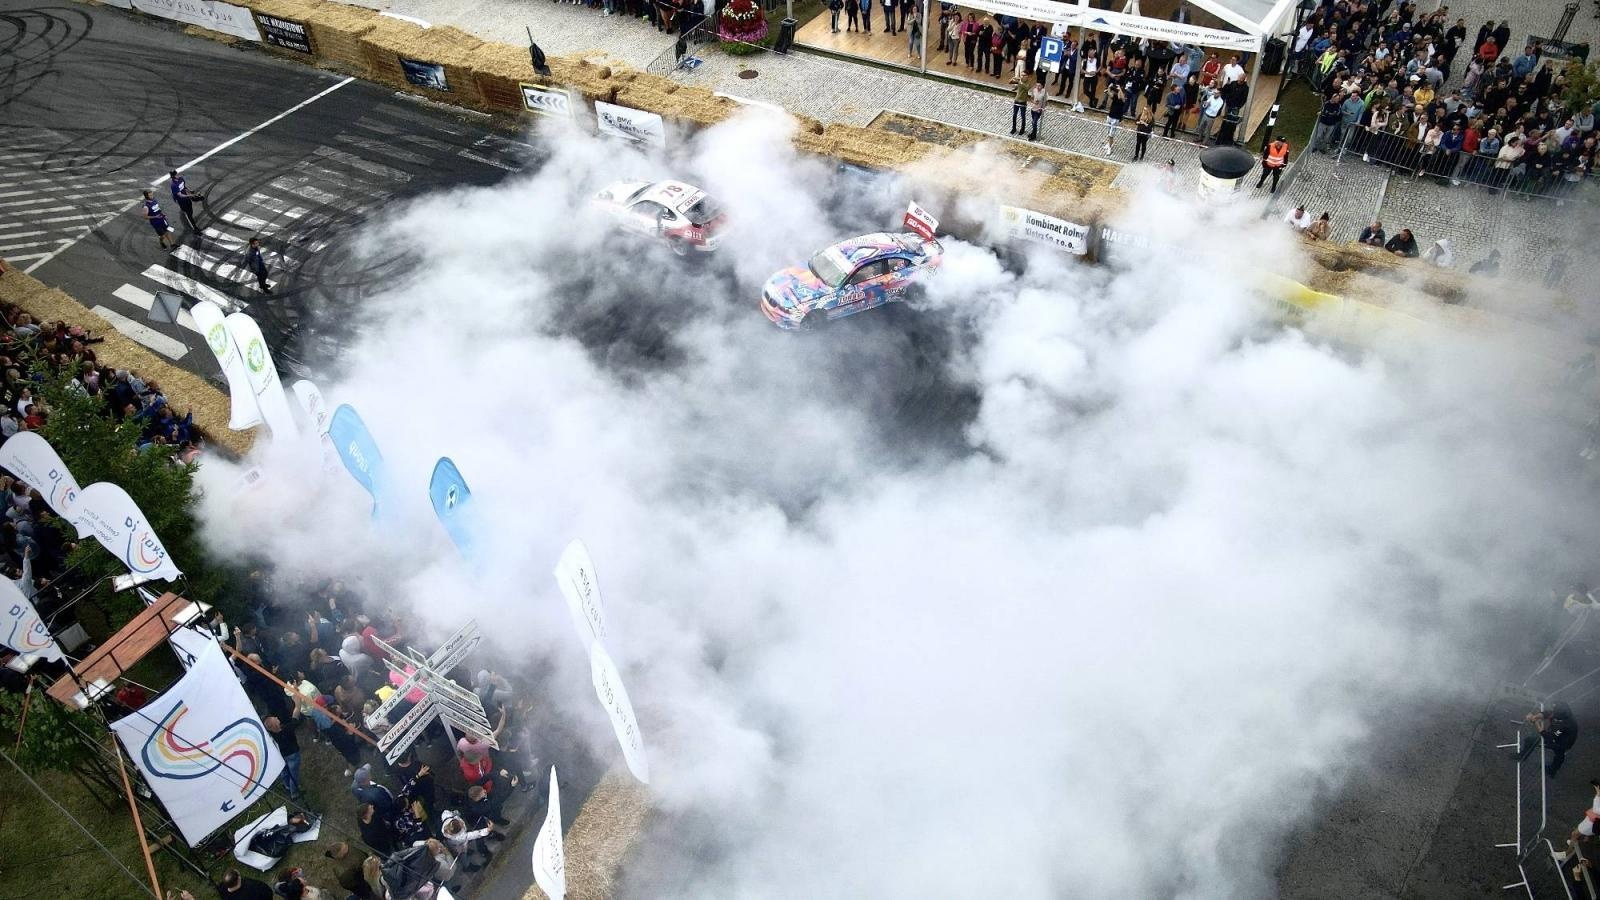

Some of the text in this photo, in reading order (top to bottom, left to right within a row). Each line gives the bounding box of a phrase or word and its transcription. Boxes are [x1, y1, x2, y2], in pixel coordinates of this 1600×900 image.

[1044, 40, 1059, 57] P
[660, 185, 682, 198] 78
[1026, 214, 1085, 240] Kombinat Rolny
